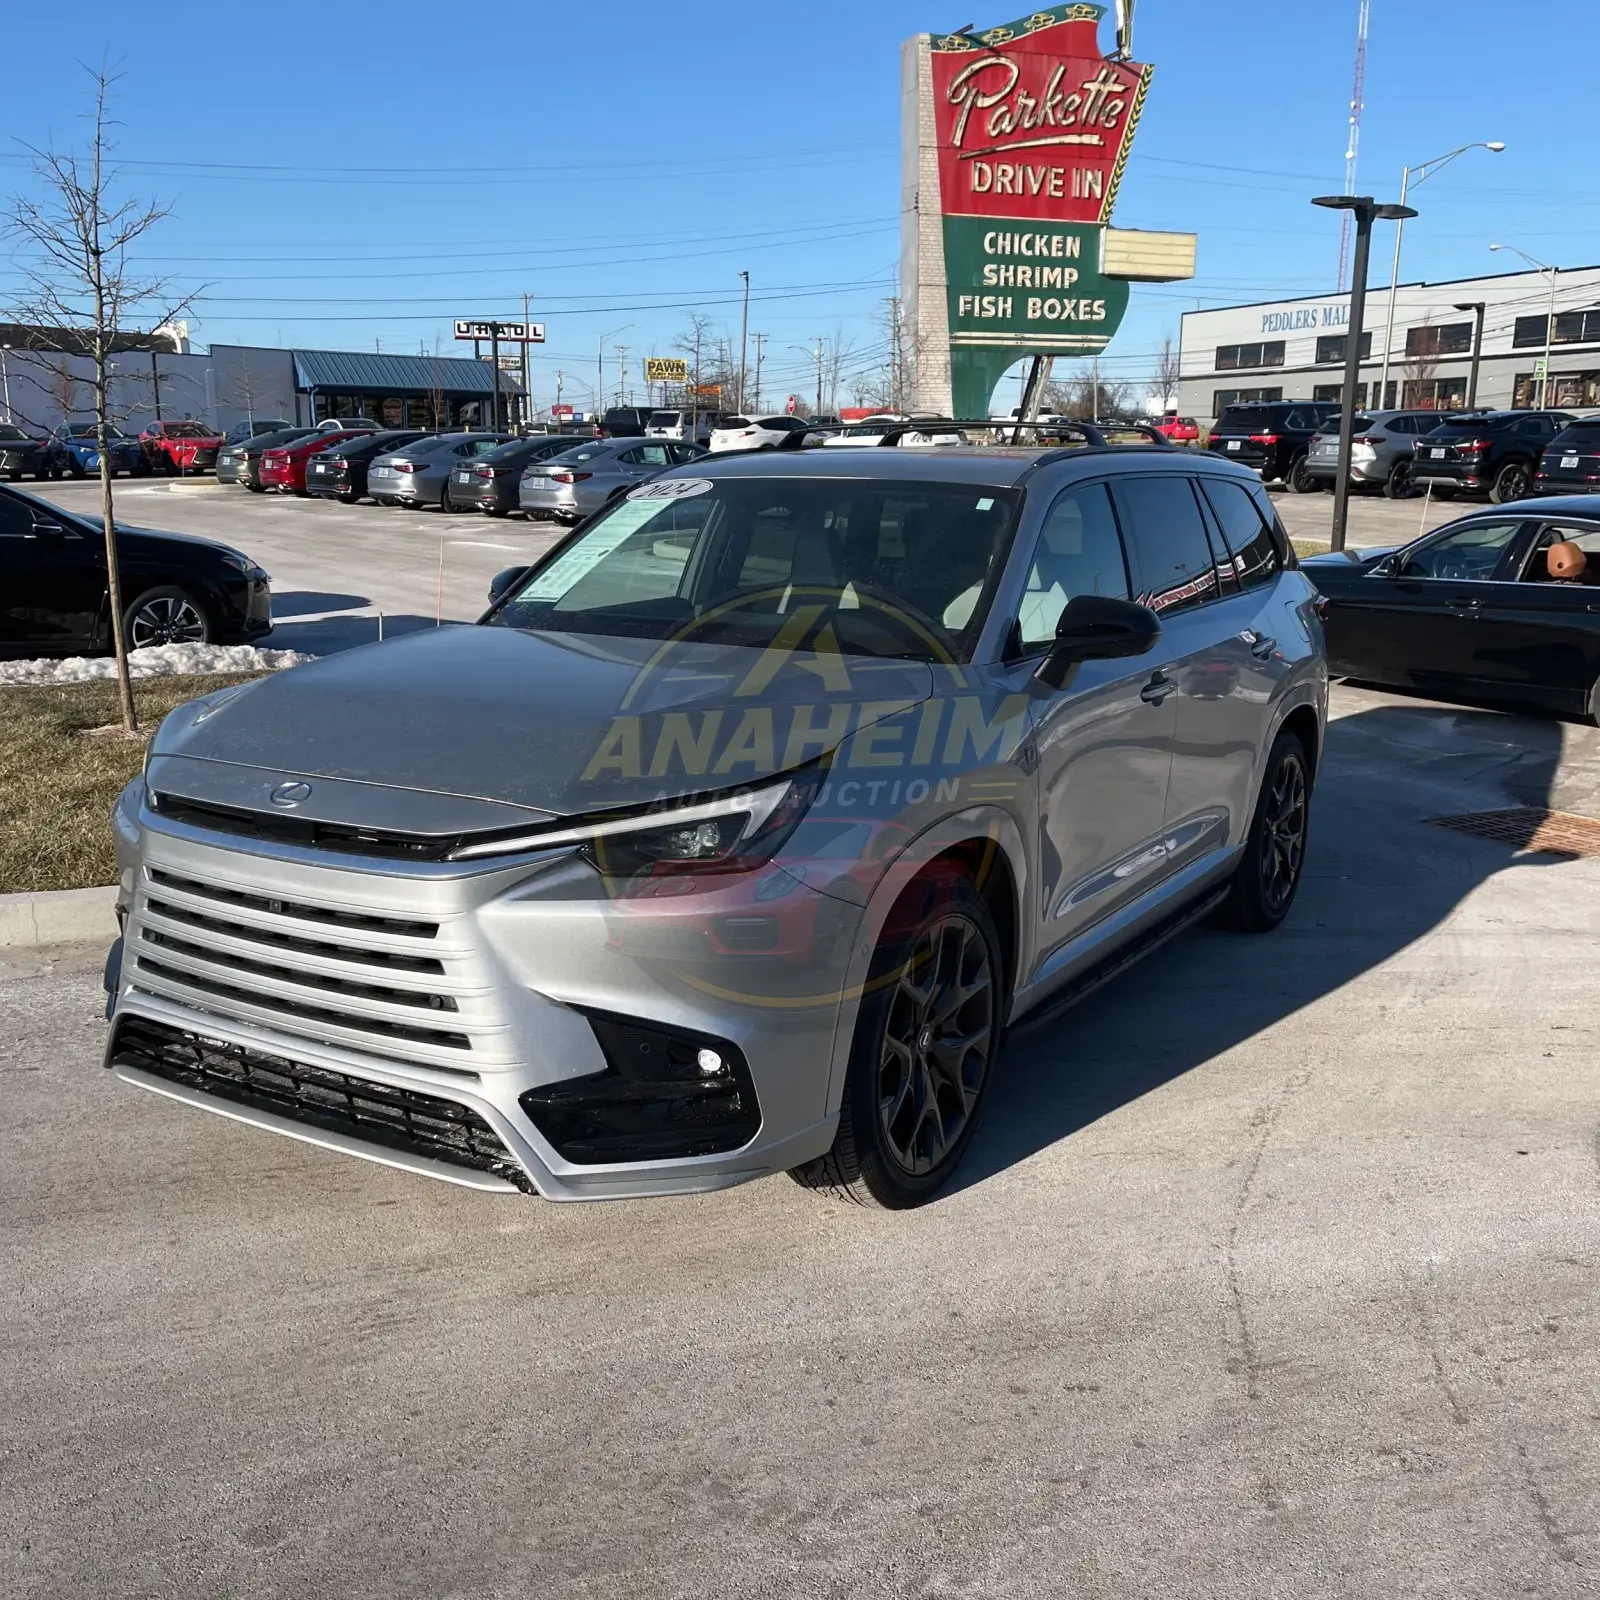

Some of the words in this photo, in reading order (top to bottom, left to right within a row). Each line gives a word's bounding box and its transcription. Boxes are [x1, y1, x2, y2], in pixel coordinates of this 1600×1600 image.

[947, 55, 1129, 147] Parkette
[971, 161, 1065, 197] DRIVE
[1072, 168, 1104, 199] IN
[983, 231, 1081, 258] CHICKEN
[983, 264, 1079, 289] SHRIMP
[958, 295, 1012, 319] FISH
[1027, 297, 1106, 321] BOXES
[1262, 309, 1317, 332] PEDDLERS
[1322, 305, 1349, 327] MAL
[647, 361, 686, 373] PAWN
[634, 482, 702, 498] 2024
